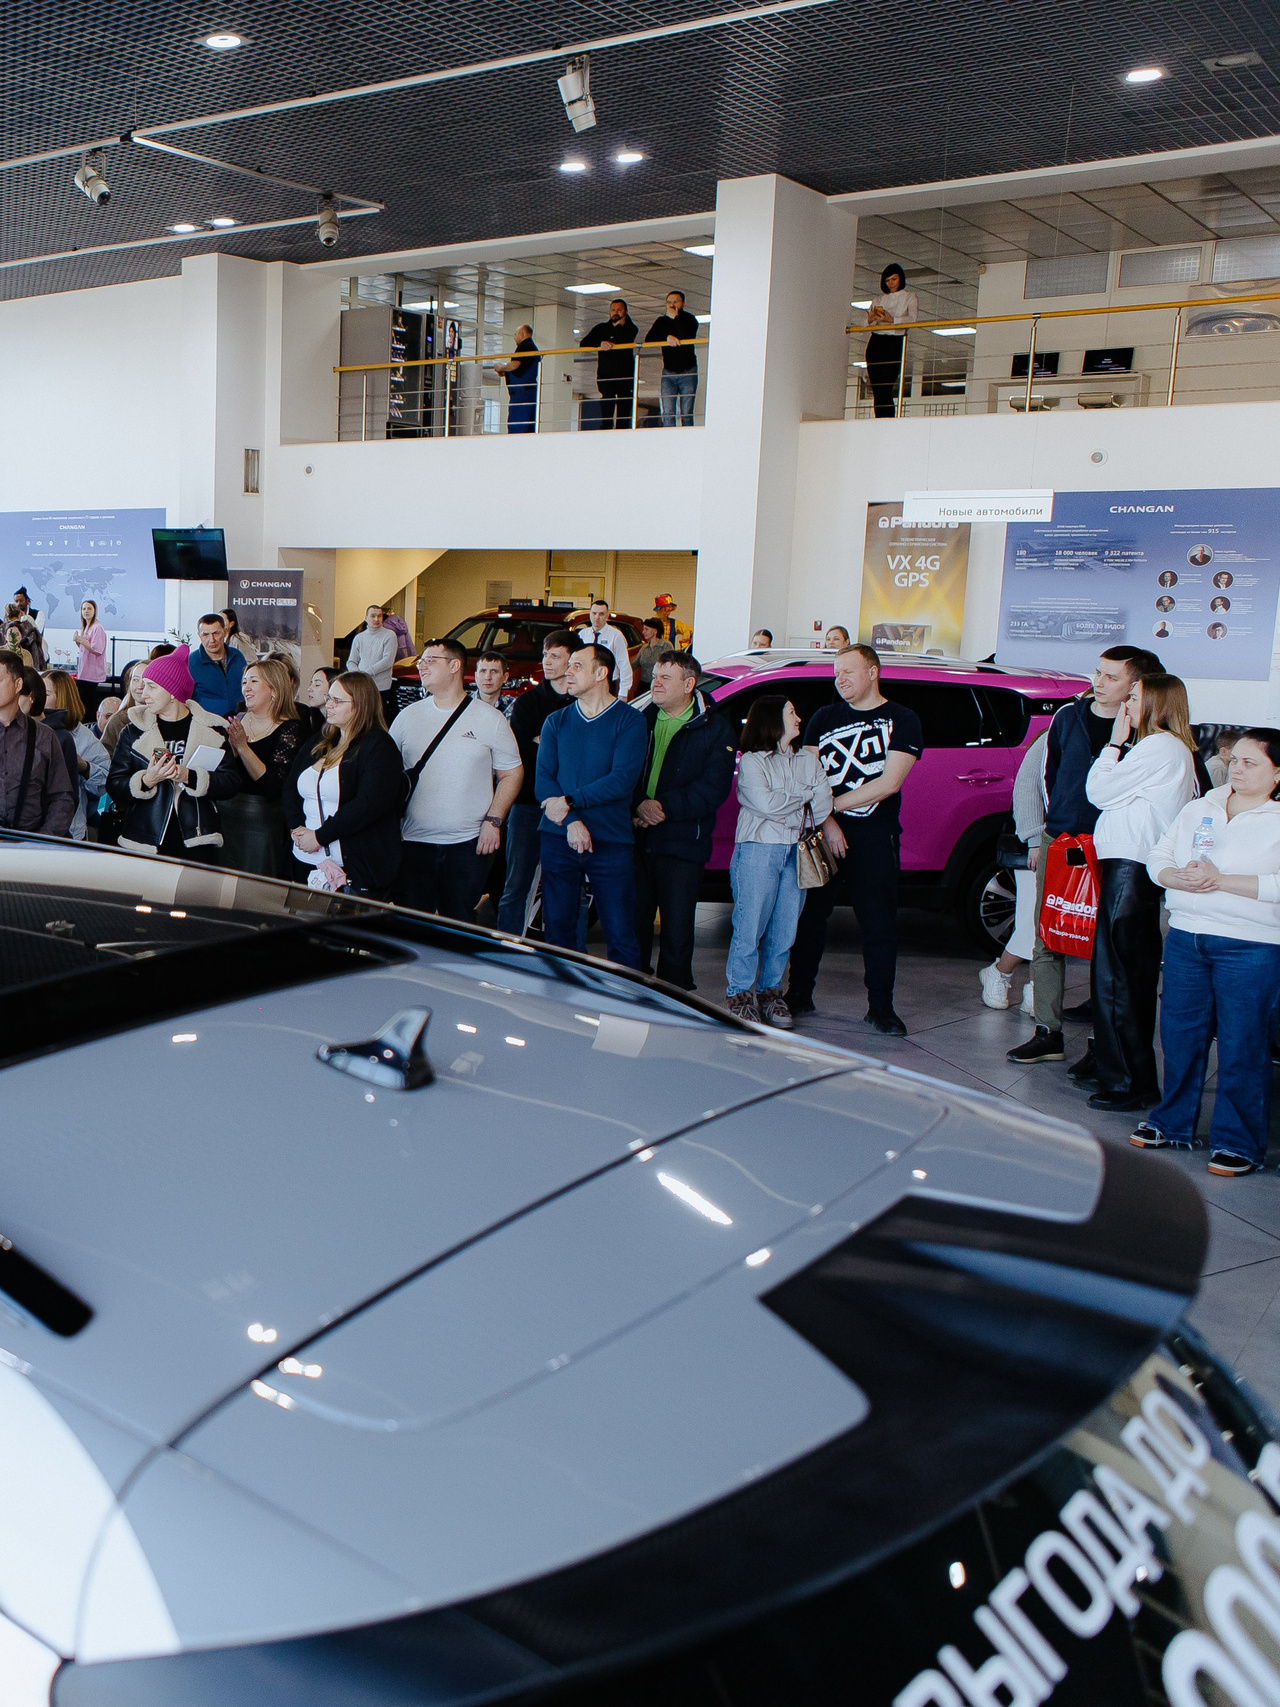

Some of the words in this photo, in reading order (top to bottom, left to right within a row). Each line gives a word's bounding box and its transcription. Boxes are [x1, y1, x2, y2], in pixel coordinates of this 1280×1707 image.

[939, 507, 973, 516] Новые
[976, 506, 1043, 516] автомобили
[1109, 505, 1174, 513] CHANGAN
[887, 555, 911, 570] VX
[915, 555, 940, 571] 4G
[894, 572, 929, 588] GPS
[232, 597, 276, 606] HUNTER
[881, 638, 910, 646] Pandora
[1122, 1389, 1212, 1524] ДО
